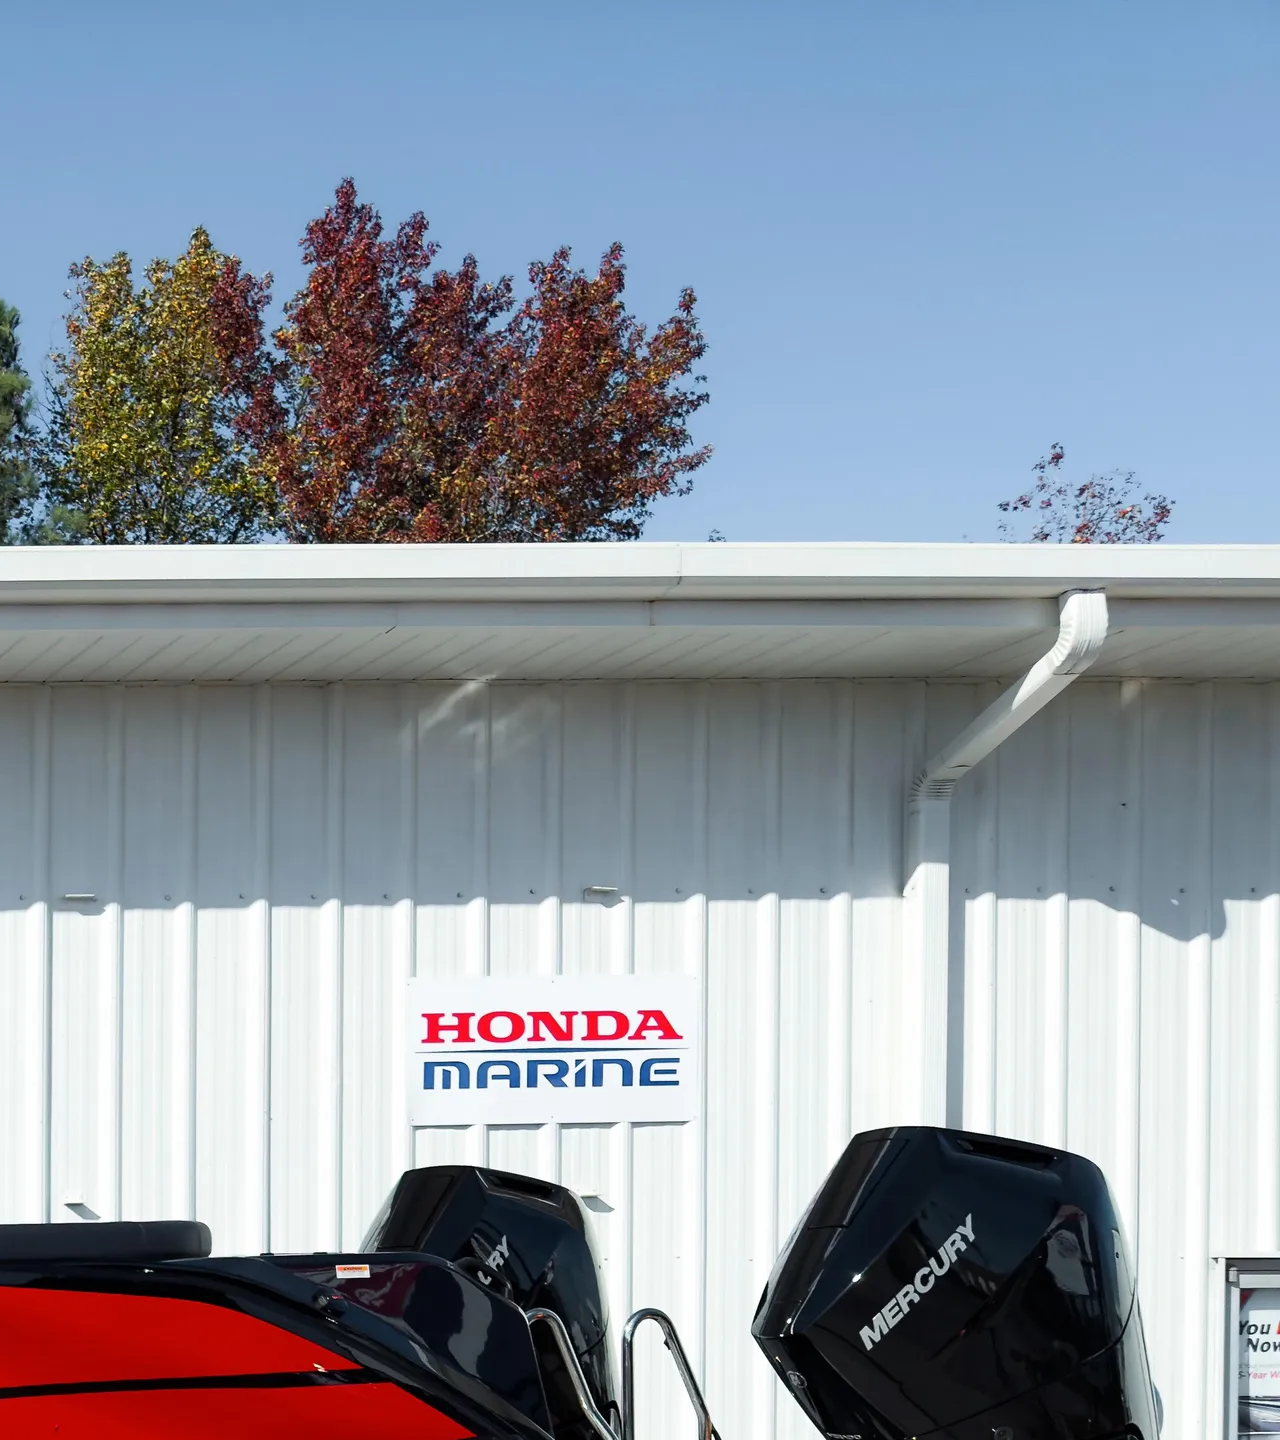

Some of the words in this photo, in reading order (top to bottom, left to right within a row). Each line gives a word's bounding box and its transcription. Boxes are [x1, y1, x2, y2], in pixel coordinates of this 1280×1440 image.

[421, 1010, 684, 1044] HONDA
[423, 1057, 681, 1090] MARINE
[858, 1212, 976, 1352] MERCURY
[1239, 1320, 1271, 1335] You
